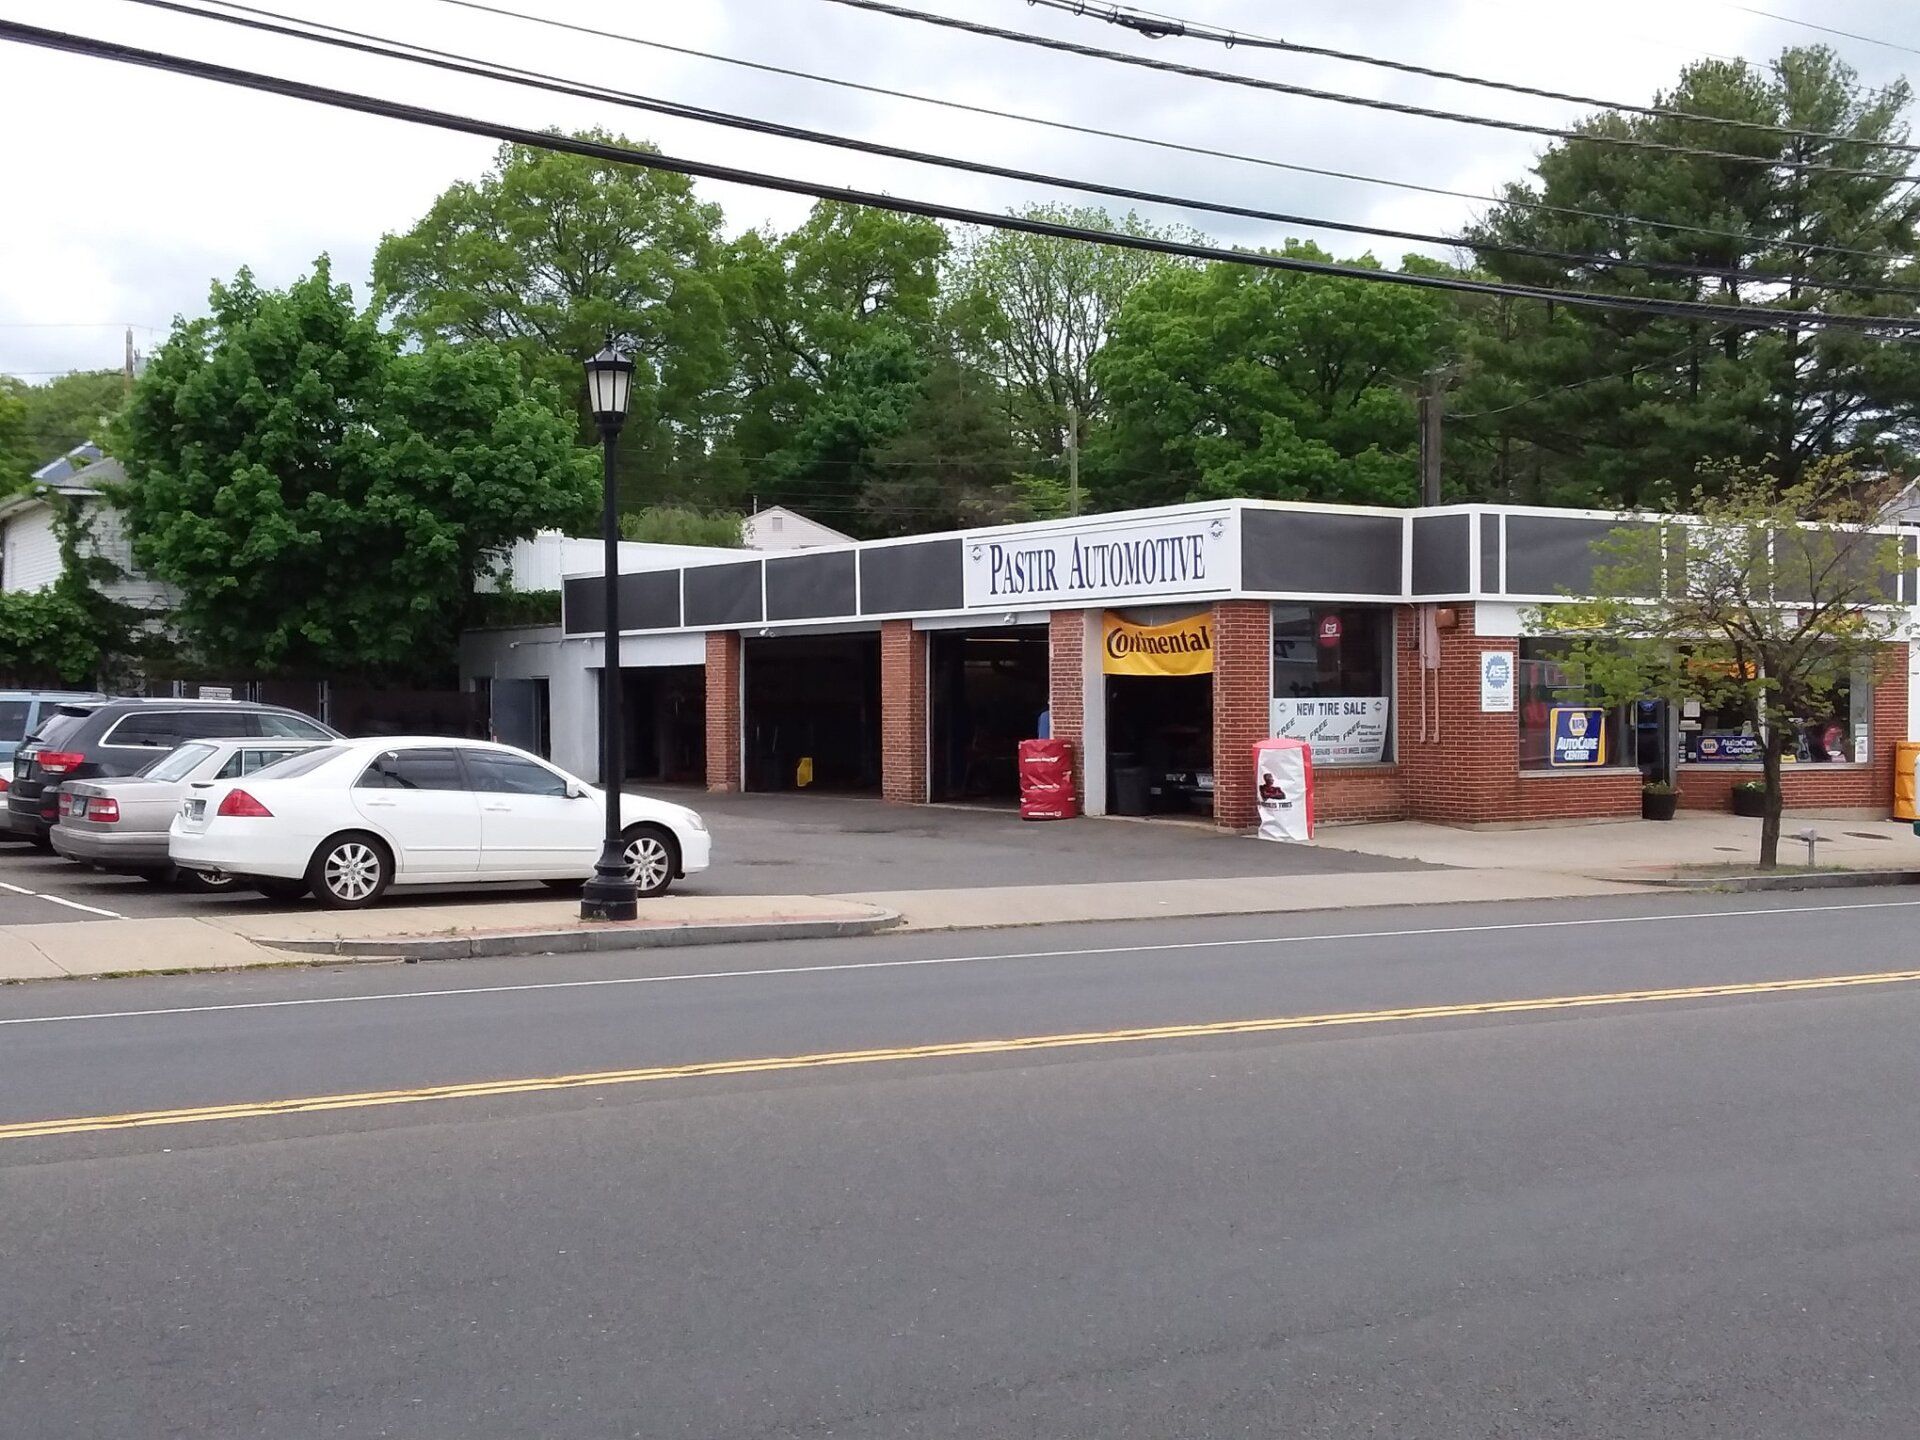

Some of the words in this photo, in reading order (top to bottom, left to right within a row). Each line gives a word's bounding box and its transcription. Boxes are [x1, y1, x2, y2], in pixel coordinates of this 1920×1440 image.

[989, 544, 1059, 595] PASTIR
[1068, 535, 1206, 590] AUTOMOTIVE
[1106, 625, 1211, 660] Continental
[1296, 702, 1315, 716] NEW
[1319, 702, 1340, 716] TIRE
[1343, 701, 1367, 715] SALE
[1276, 717, 1296, 739] FREE
[1309, 718, 1329, 741] FREE
[1342, 720, 1362, 741] FREE
[1721, 738, 1757, 747] AutoCar
[1725, 746, 1754, 754] Center
